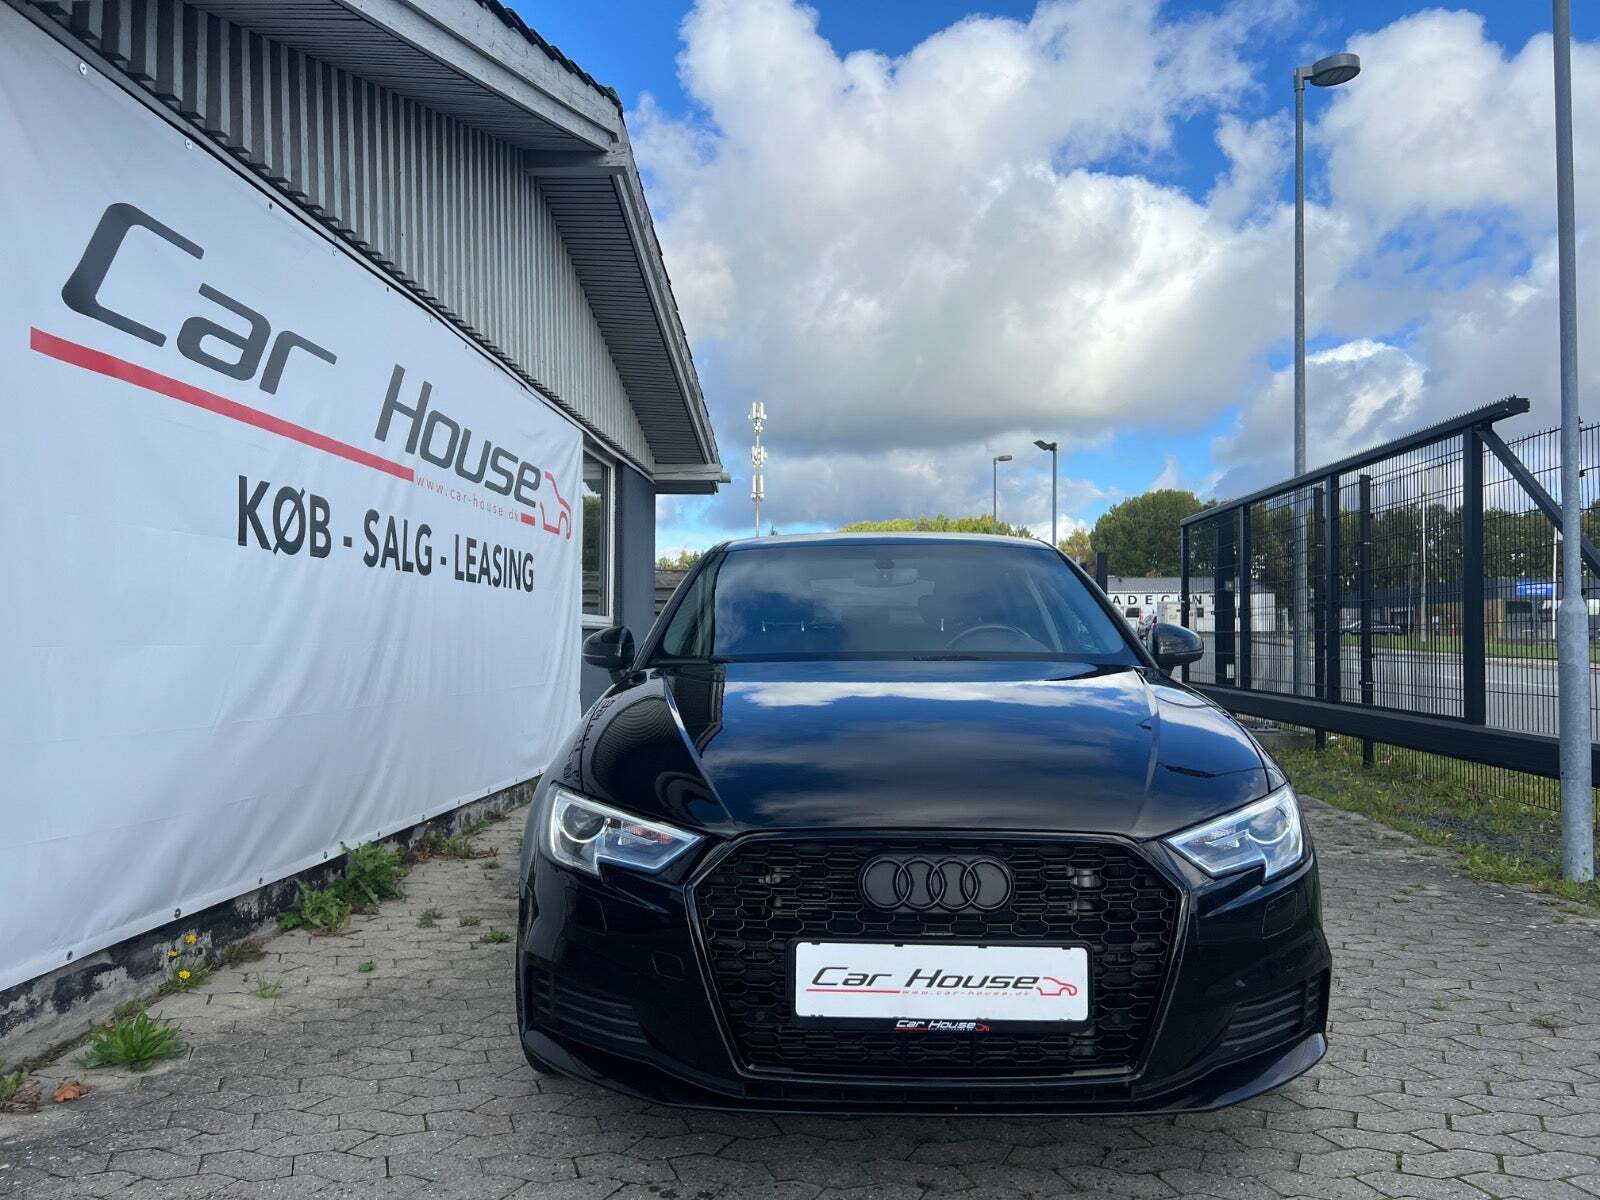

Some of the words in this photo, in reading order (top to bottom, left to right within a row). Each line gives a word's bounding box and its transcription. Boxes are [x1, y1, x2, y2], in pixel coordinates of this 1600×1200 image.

[61, 202, 337, 395] Car
[374, 363, 542, 509] House
[416, 475, 520, 522] www.car-house.dk
[237, 474, 332, 559] KØB
[363, 508, 433, 577] SALG
[454, 533, 534, 593] LEASING
[811, 966, 892, 987] Car
[904, 968, 1040, 990] House
[895, 1020, 925, 1029] Car
[928, 1020, 976, 1031] House
